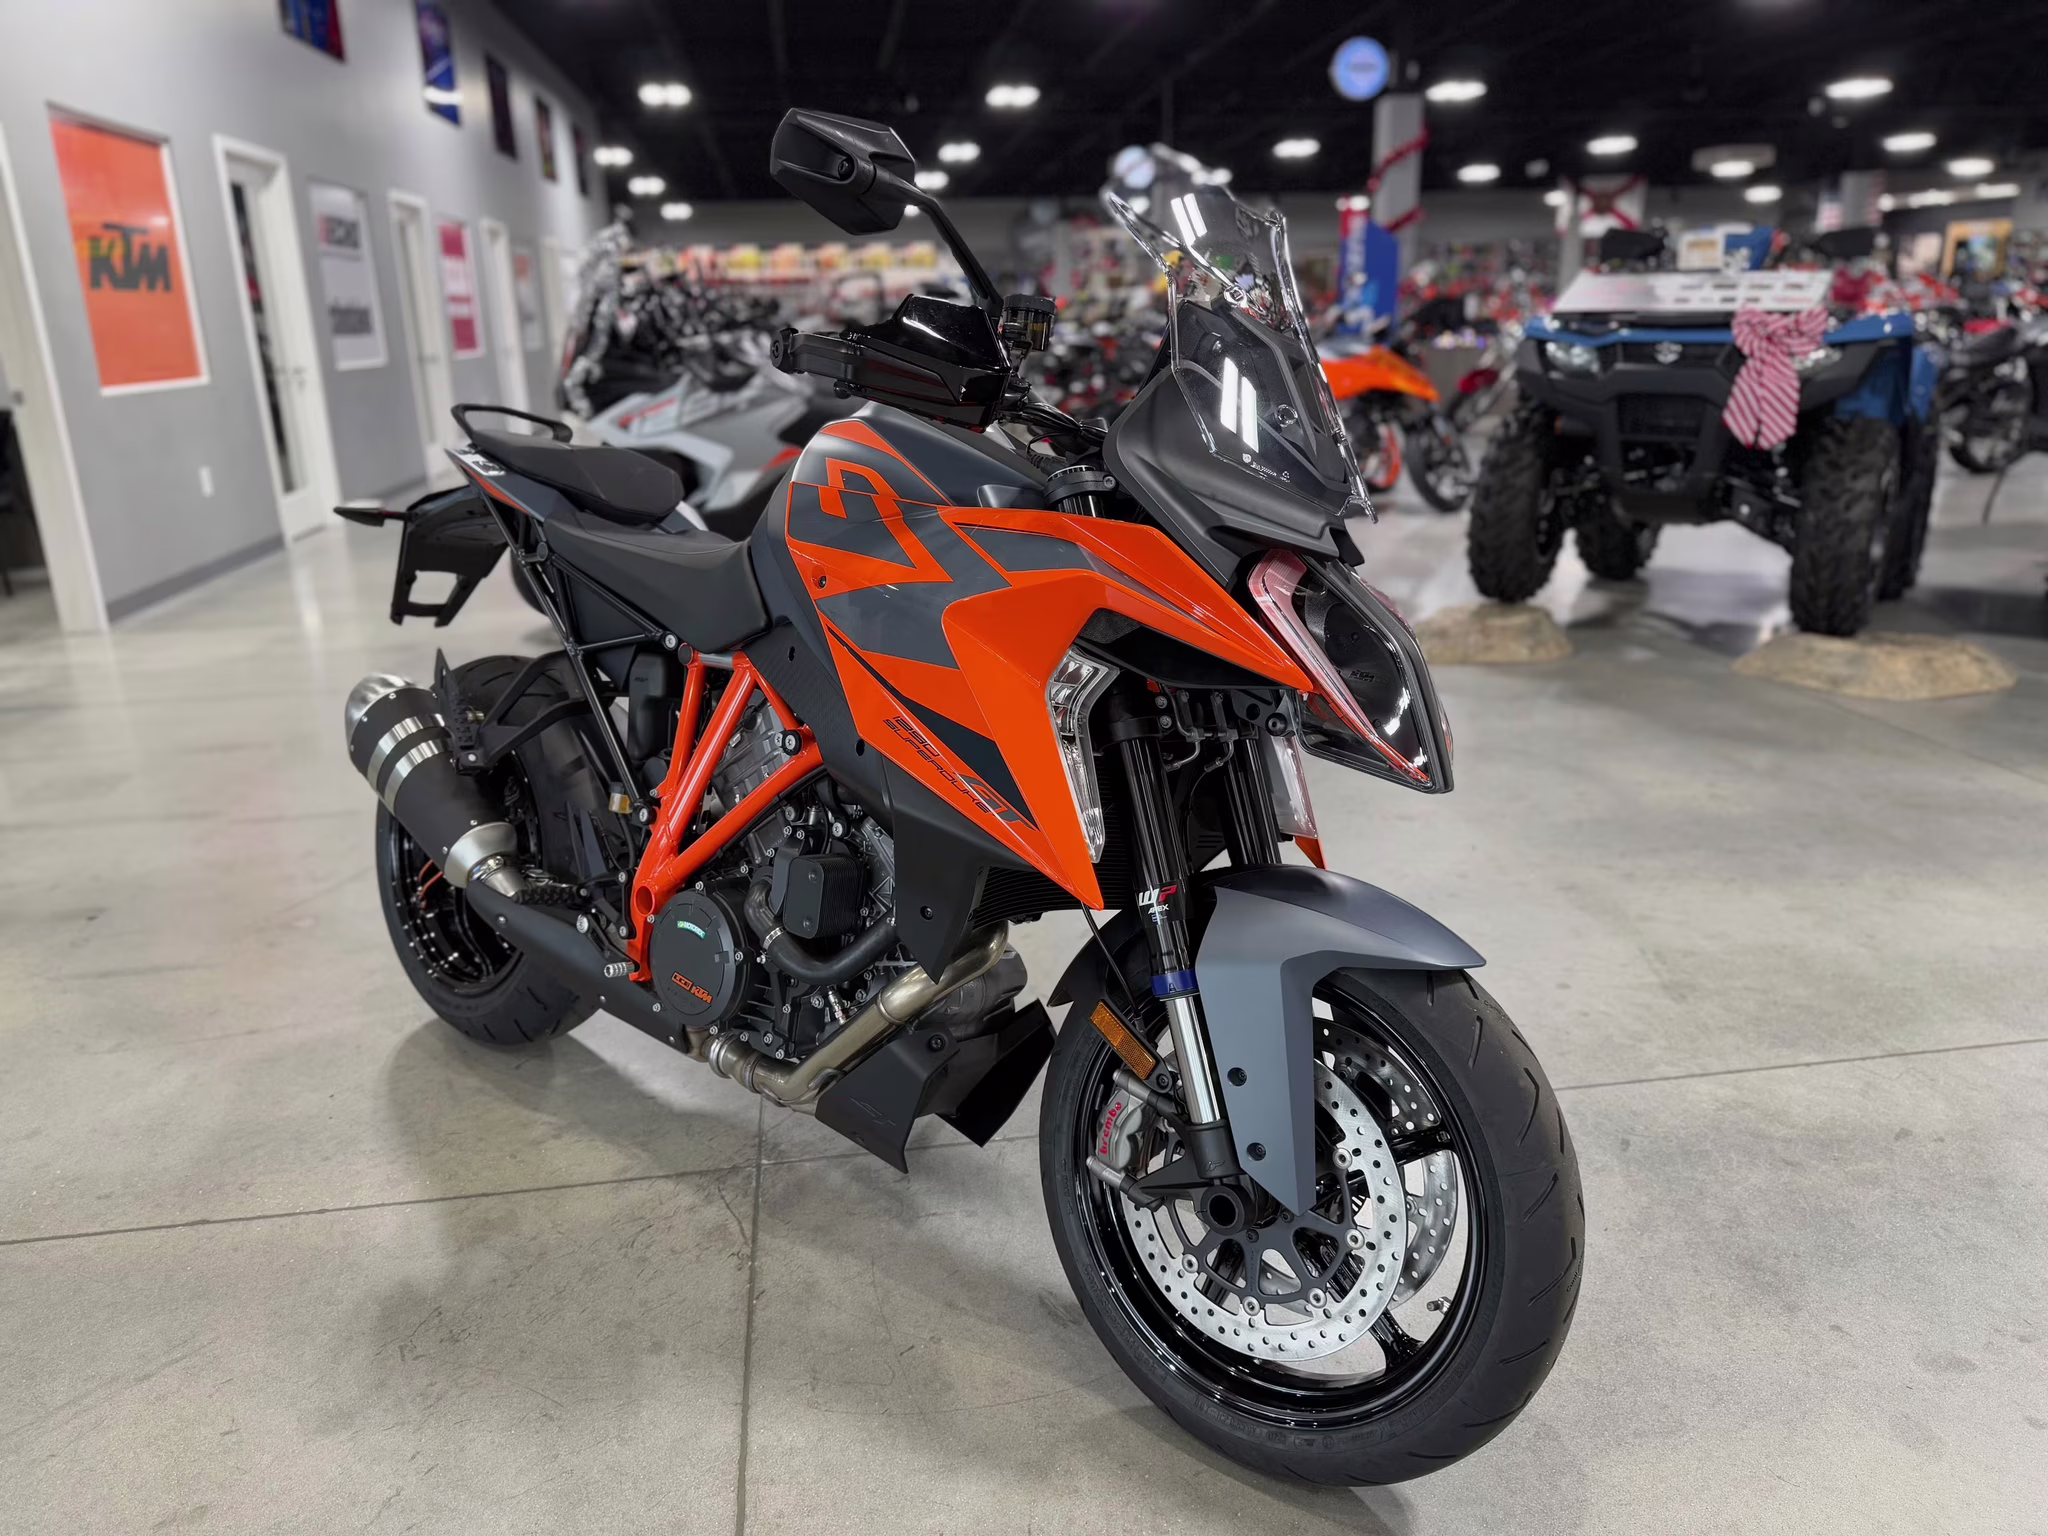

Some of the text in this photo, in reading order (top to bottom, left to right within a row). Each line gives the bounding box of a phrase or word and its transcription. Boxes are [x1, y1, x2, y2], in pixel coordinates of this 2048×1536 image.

[88, 222, 172, 292] KTM
[893, 716, 940, 757] 1290
[1148, 903, 1169, 914] APEX
[691, 986, 713, 1005] KTM
[1100, 1101, 1123, 1157] brembo
